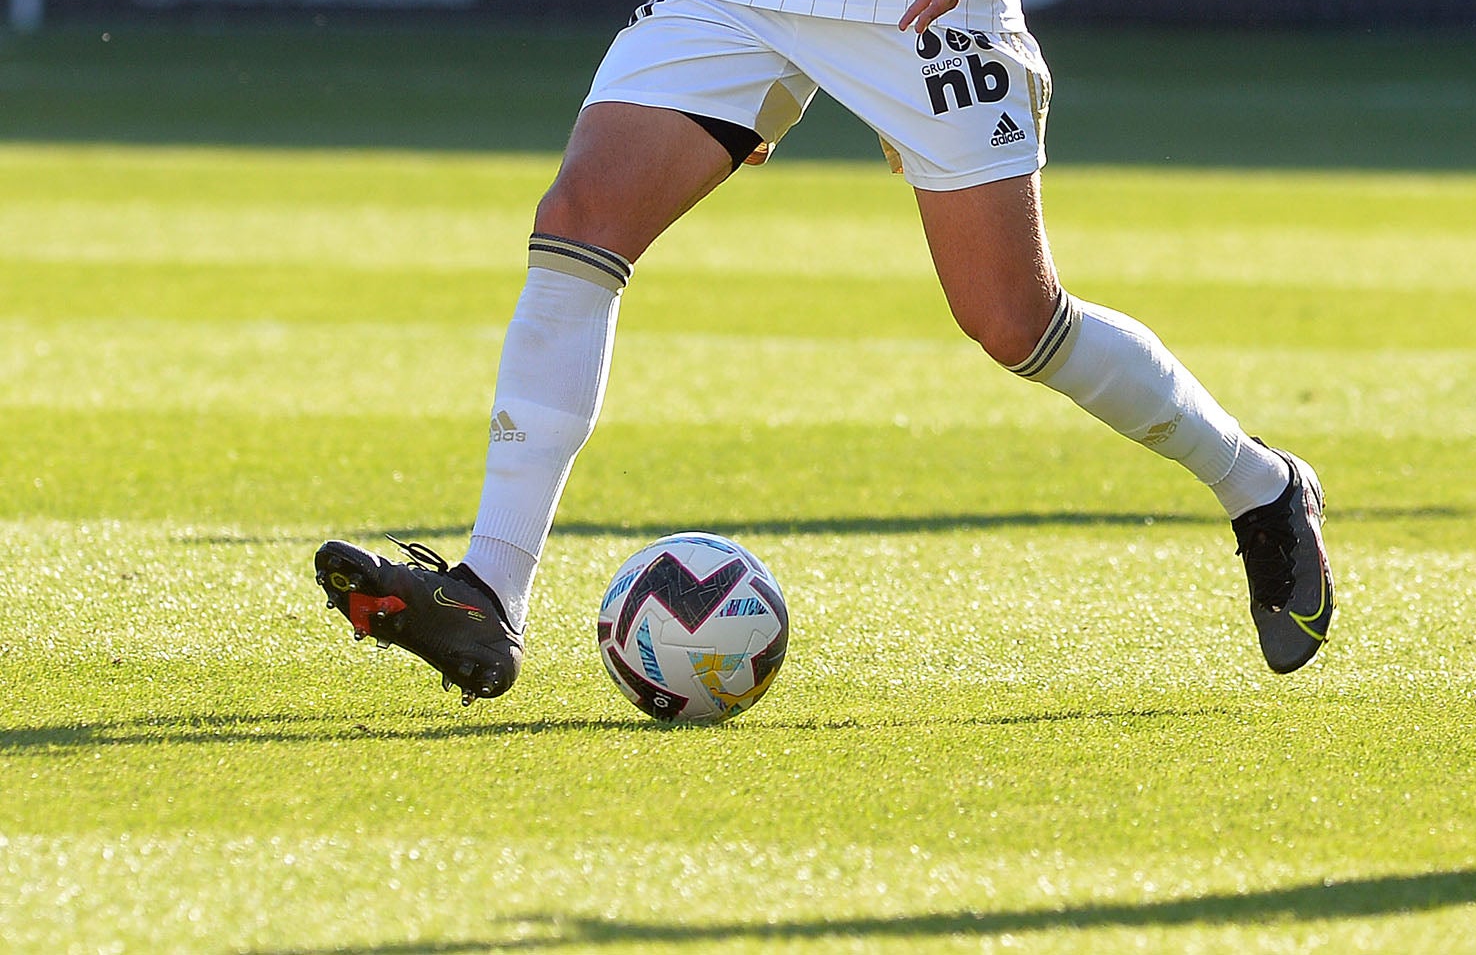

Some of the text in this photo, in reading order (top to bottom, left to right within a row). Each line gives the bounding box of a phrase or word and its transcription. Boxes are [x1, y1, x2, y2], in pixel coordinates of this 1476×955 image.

[921, 57, 963, 76] GRUPO
[924, 53, 1010, 115] nb
[990, 129, 1026, 147] adidas
